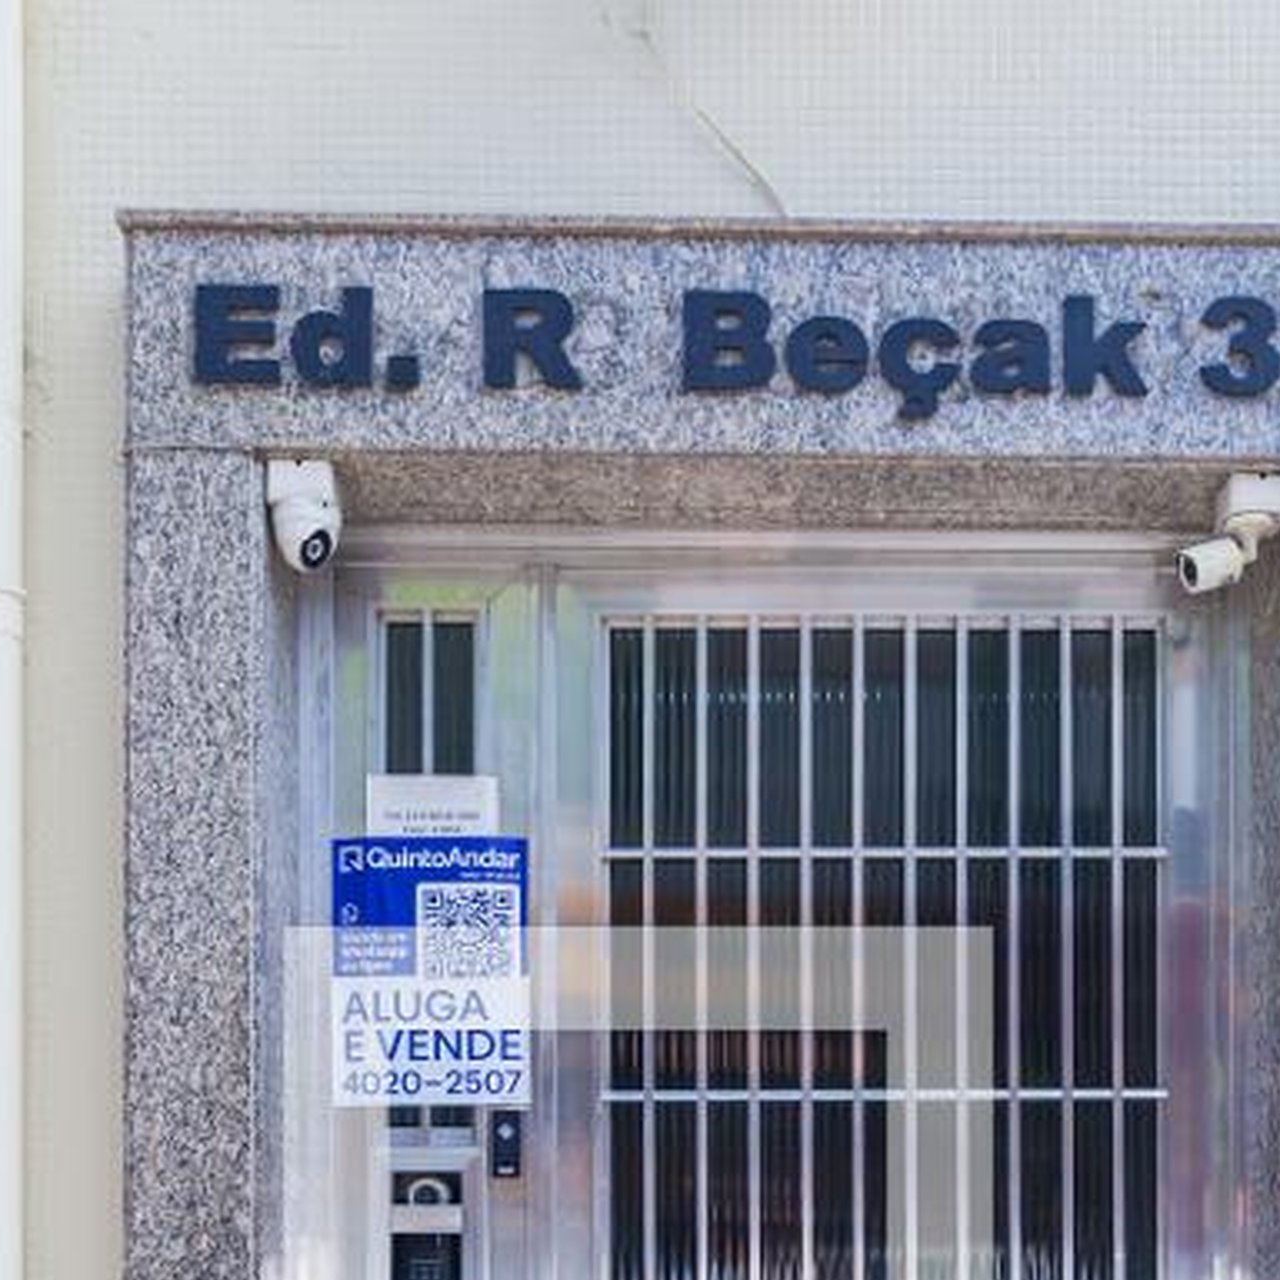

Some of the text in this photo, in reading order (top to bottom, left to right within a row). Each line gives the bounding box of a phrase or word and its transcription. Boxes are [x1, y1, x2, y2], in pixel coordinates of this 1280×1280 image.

[192, 283, 423, 391] Ed.
[481, 288, 583, 394] R
[680, 289, 1149, 425] Beçak
[367, 847, 521, 869] QuintoAndar
[342, 990, 489, 1023] ALUGA
[345, 1029, 523, 1062] E VENDE
[342, 1070, 523, 1095] 4020-2507
